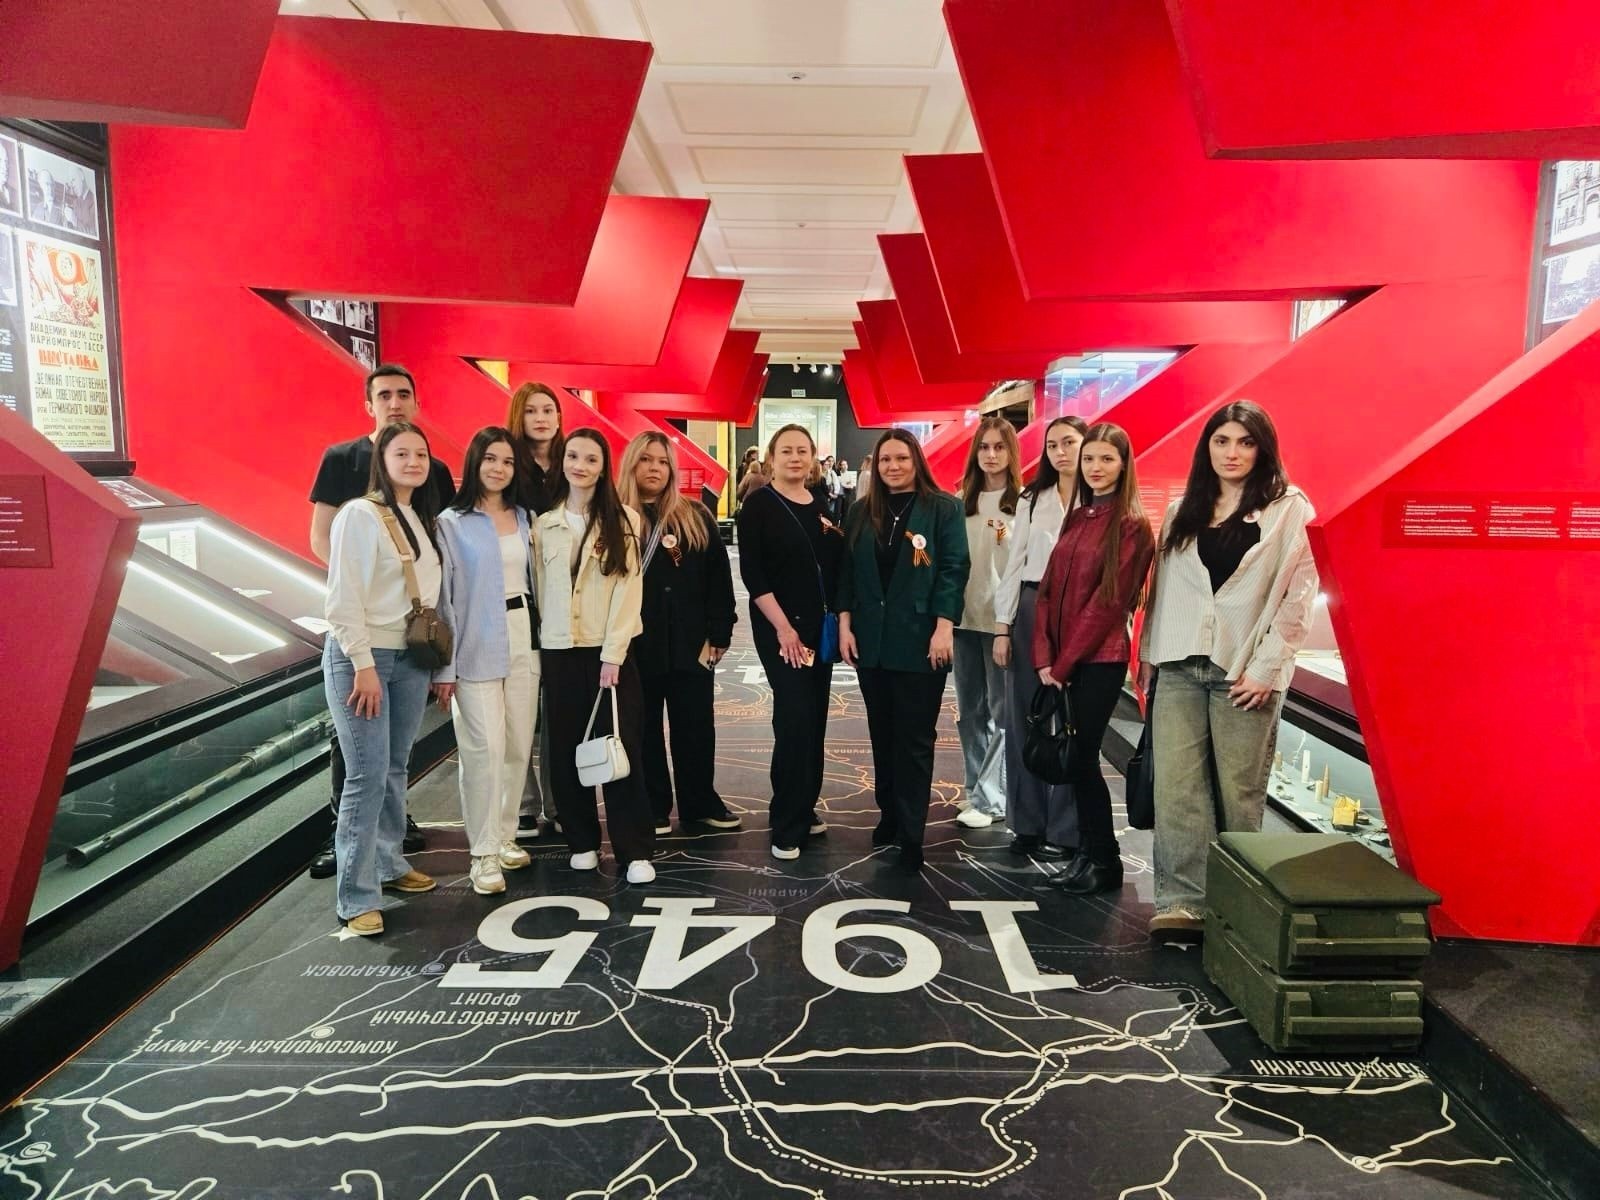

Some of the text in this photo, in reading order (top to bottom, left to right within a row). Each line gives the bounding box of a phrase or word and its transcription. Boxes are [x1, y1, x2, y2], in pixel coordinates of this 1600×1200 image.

[30, 322, 104, 342] АКАДЕМИЯ НАУК СССР
[30, 333, 81, 350] НАРКОМПРОС
[38, 349, 99, 369] ВЫСТАВКА
[437, 895, 1078, 994] 1945
[299, 962, 416, 979] ХАБАРОВСК
[449, 991, 522, 1007] ФРОНТ
[369, 1010, 581, 1027] ДАЛЬНЕВОСТОЧНЫЙ
[132, 1038, 399, 1055] КОМСОМОЛЬСК-НА-АМУРЕ
